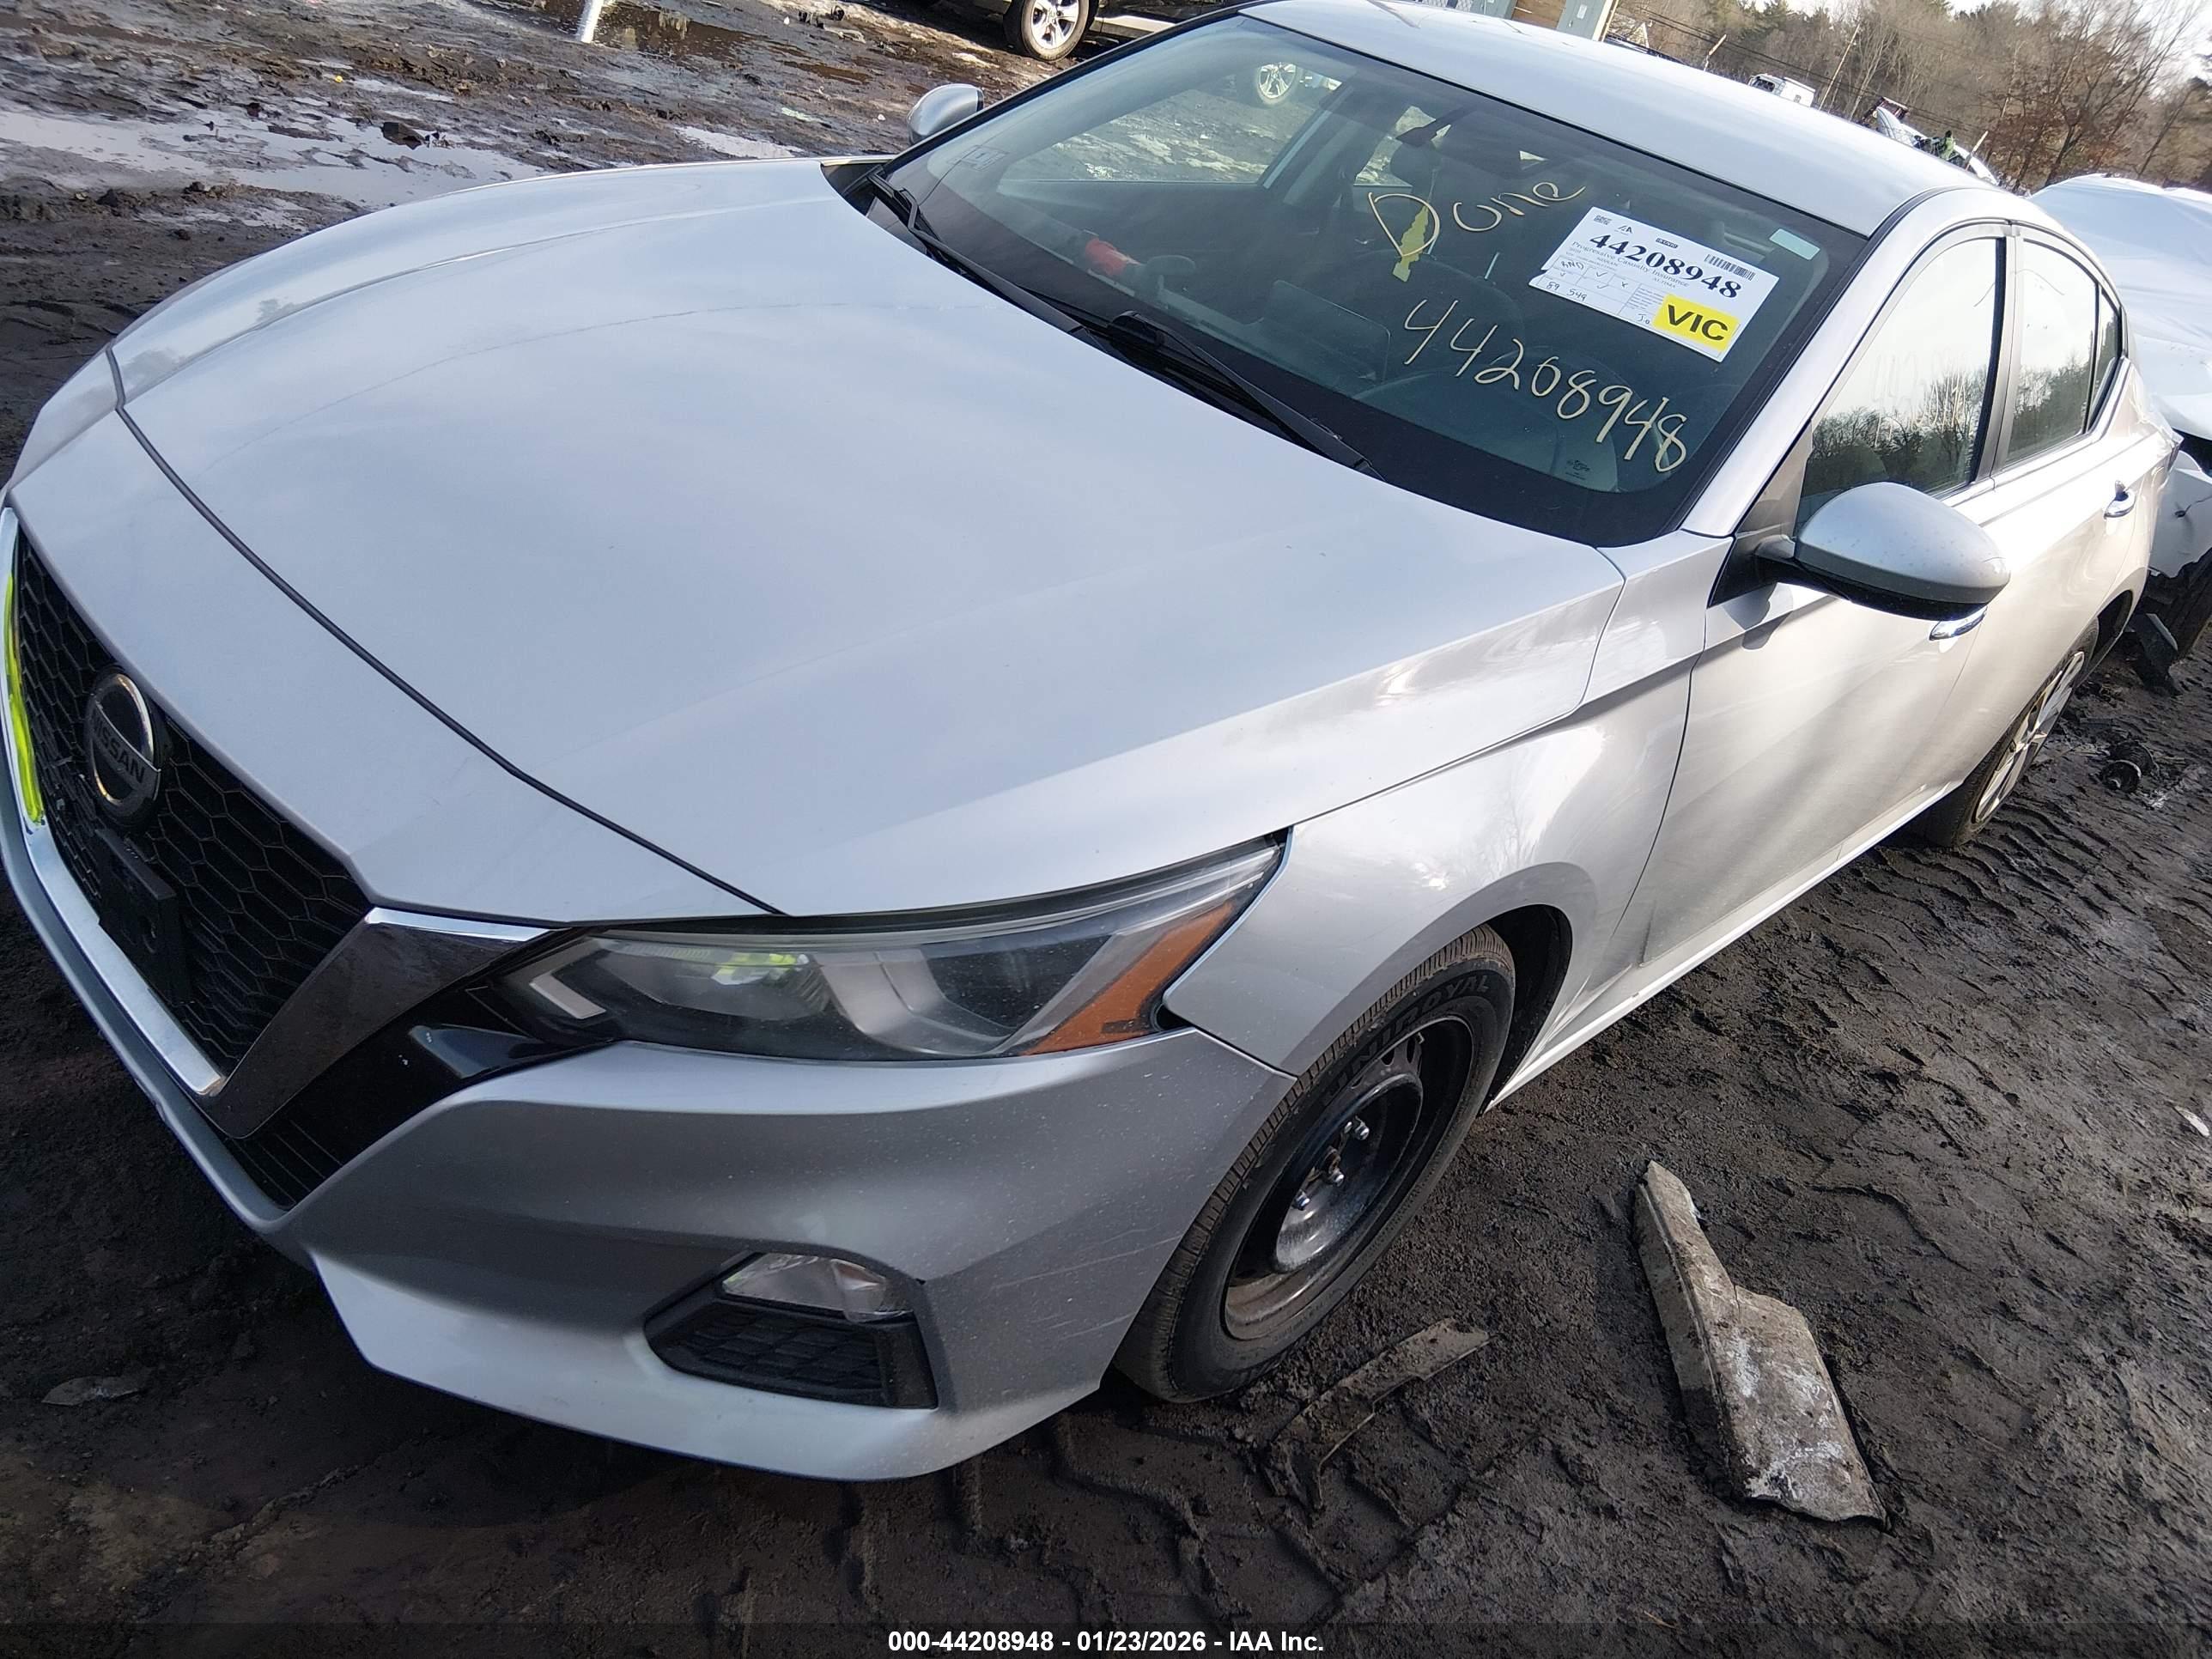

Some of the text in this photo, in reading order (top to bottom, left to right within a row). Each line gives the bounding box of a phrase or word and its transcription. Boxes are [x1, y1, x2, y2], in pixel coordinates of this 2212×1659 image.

[1590, 234, 1741, 298] 44208948
[1651, 270, 1690, 287] Insurance
[1668, 304, 1728, 340] VIC
[1405, 299, 1687, 472] 44208948
